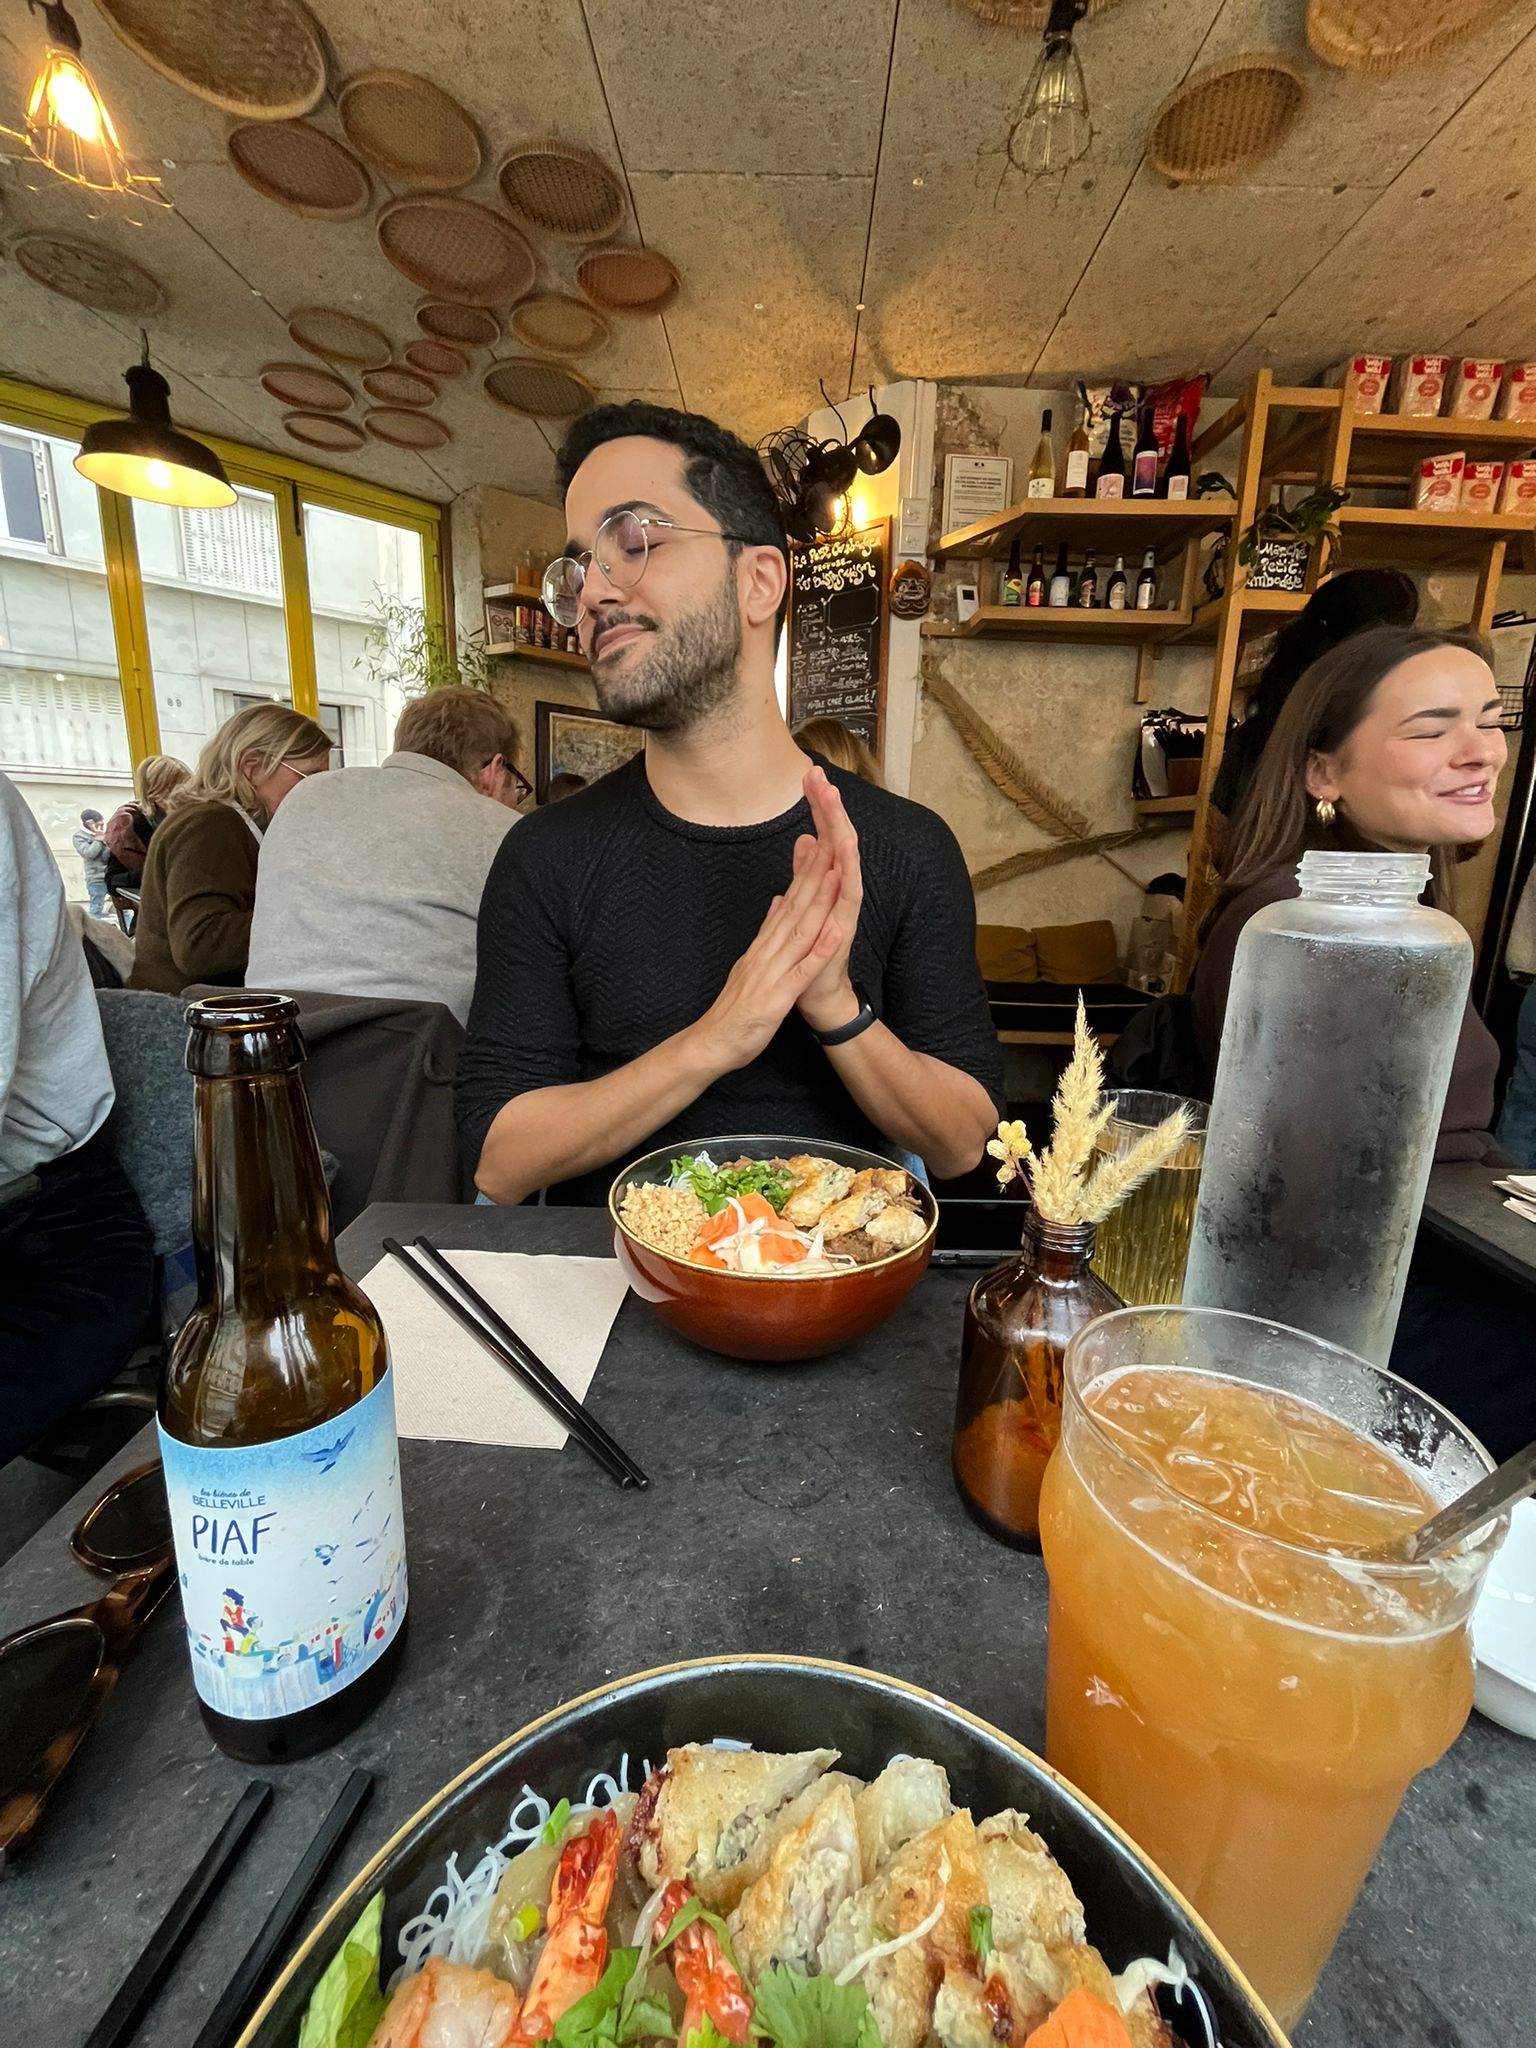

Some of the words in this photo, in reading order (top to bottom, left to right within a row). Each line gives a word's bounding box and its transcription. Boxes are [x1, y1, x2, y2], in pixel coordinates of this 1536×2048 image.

[1246, 572, 1303, 590] ambodge
[200, 1487, 211, 1496] les
[239, 1488, 251, 1497] de
[192, 1495, 266, 1509] BELLEVILLE
[192, 1511, 277, 1555] PIAF
[231, 1558, 255, 1566] table
